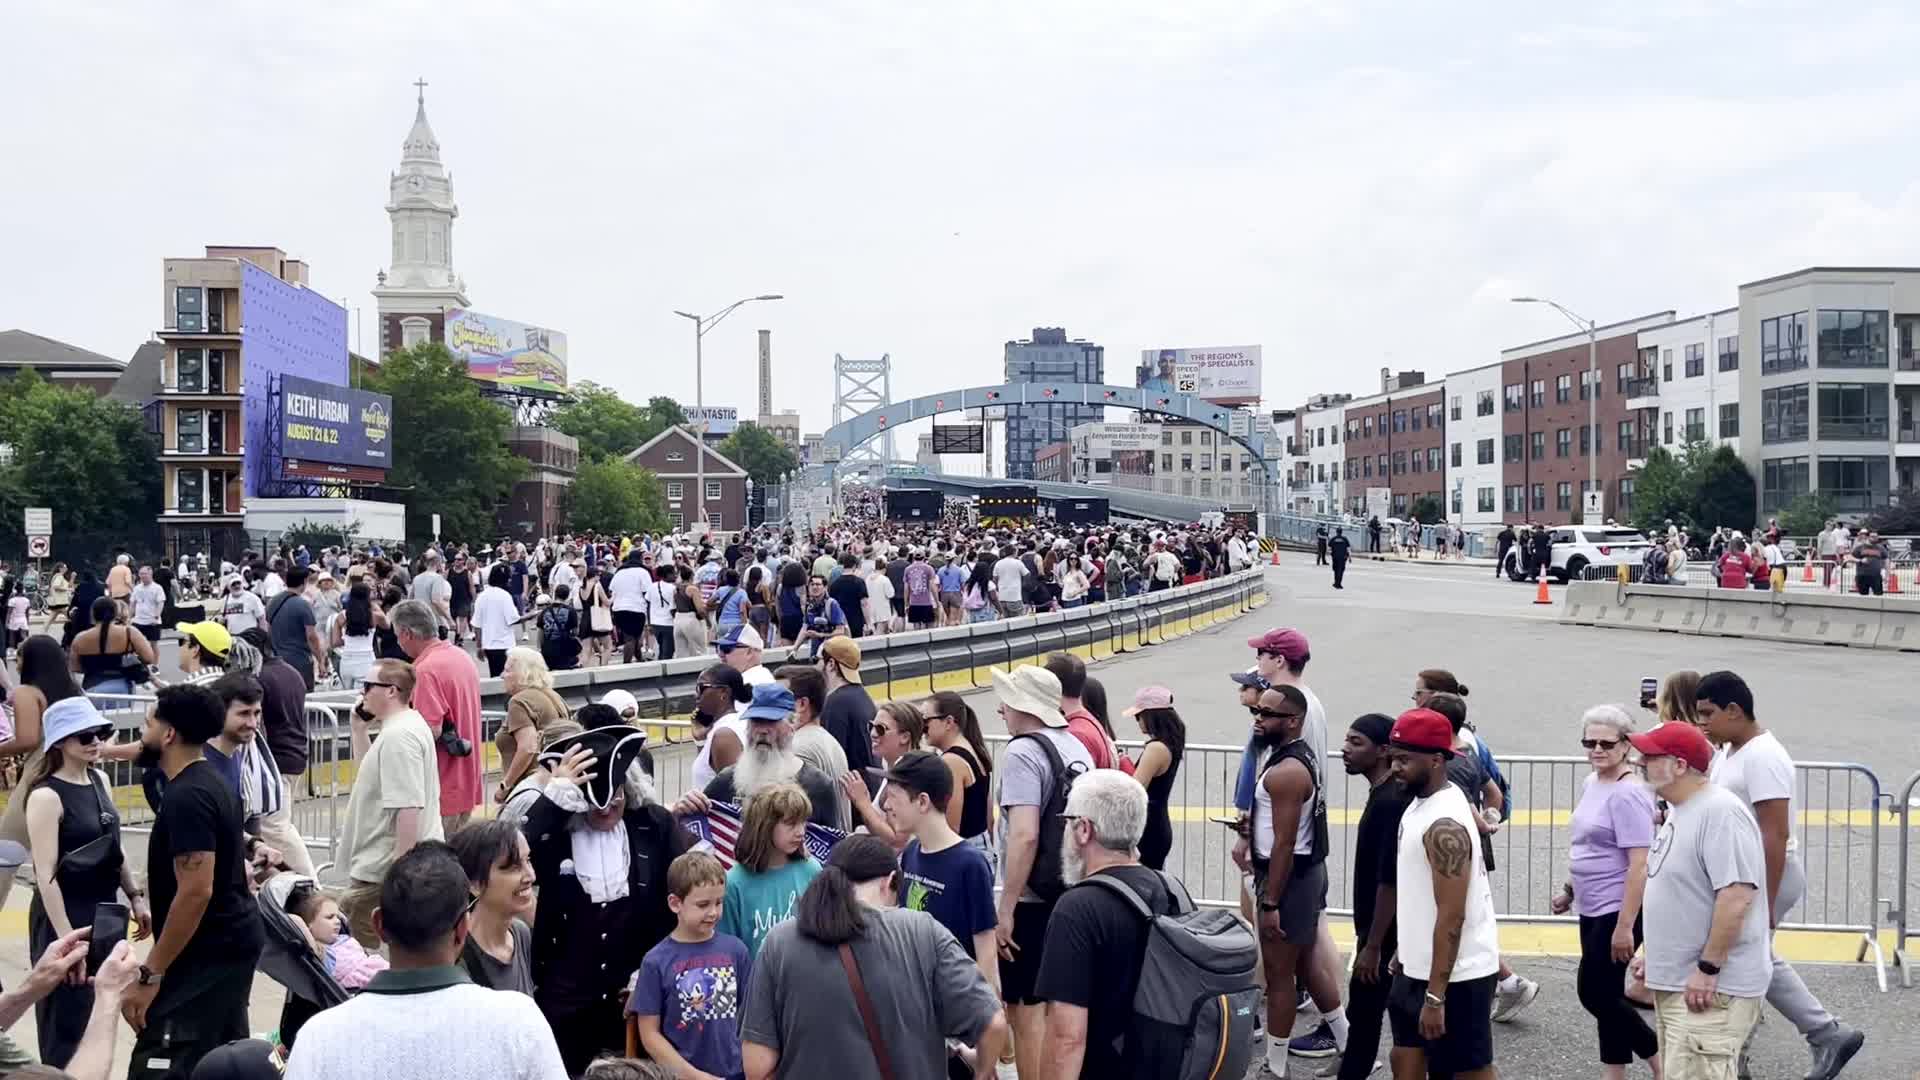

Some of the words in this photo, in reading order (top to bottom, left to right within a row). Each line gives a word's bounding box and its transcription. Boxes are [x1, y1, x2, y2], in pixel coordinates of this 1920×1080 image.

[1207, 352, 1244, 360] REGION'S
[1180, 381, 1194, 391] 45
[287, 392, 317, 419] KEITH
[318, 400, 349, 424] URBAN
[287, 423, 315, 441] AUGUST
[315, 427, 323, 442] 21
[323, 429, 329, 443] &
[330, 429, 339, 444] 22
